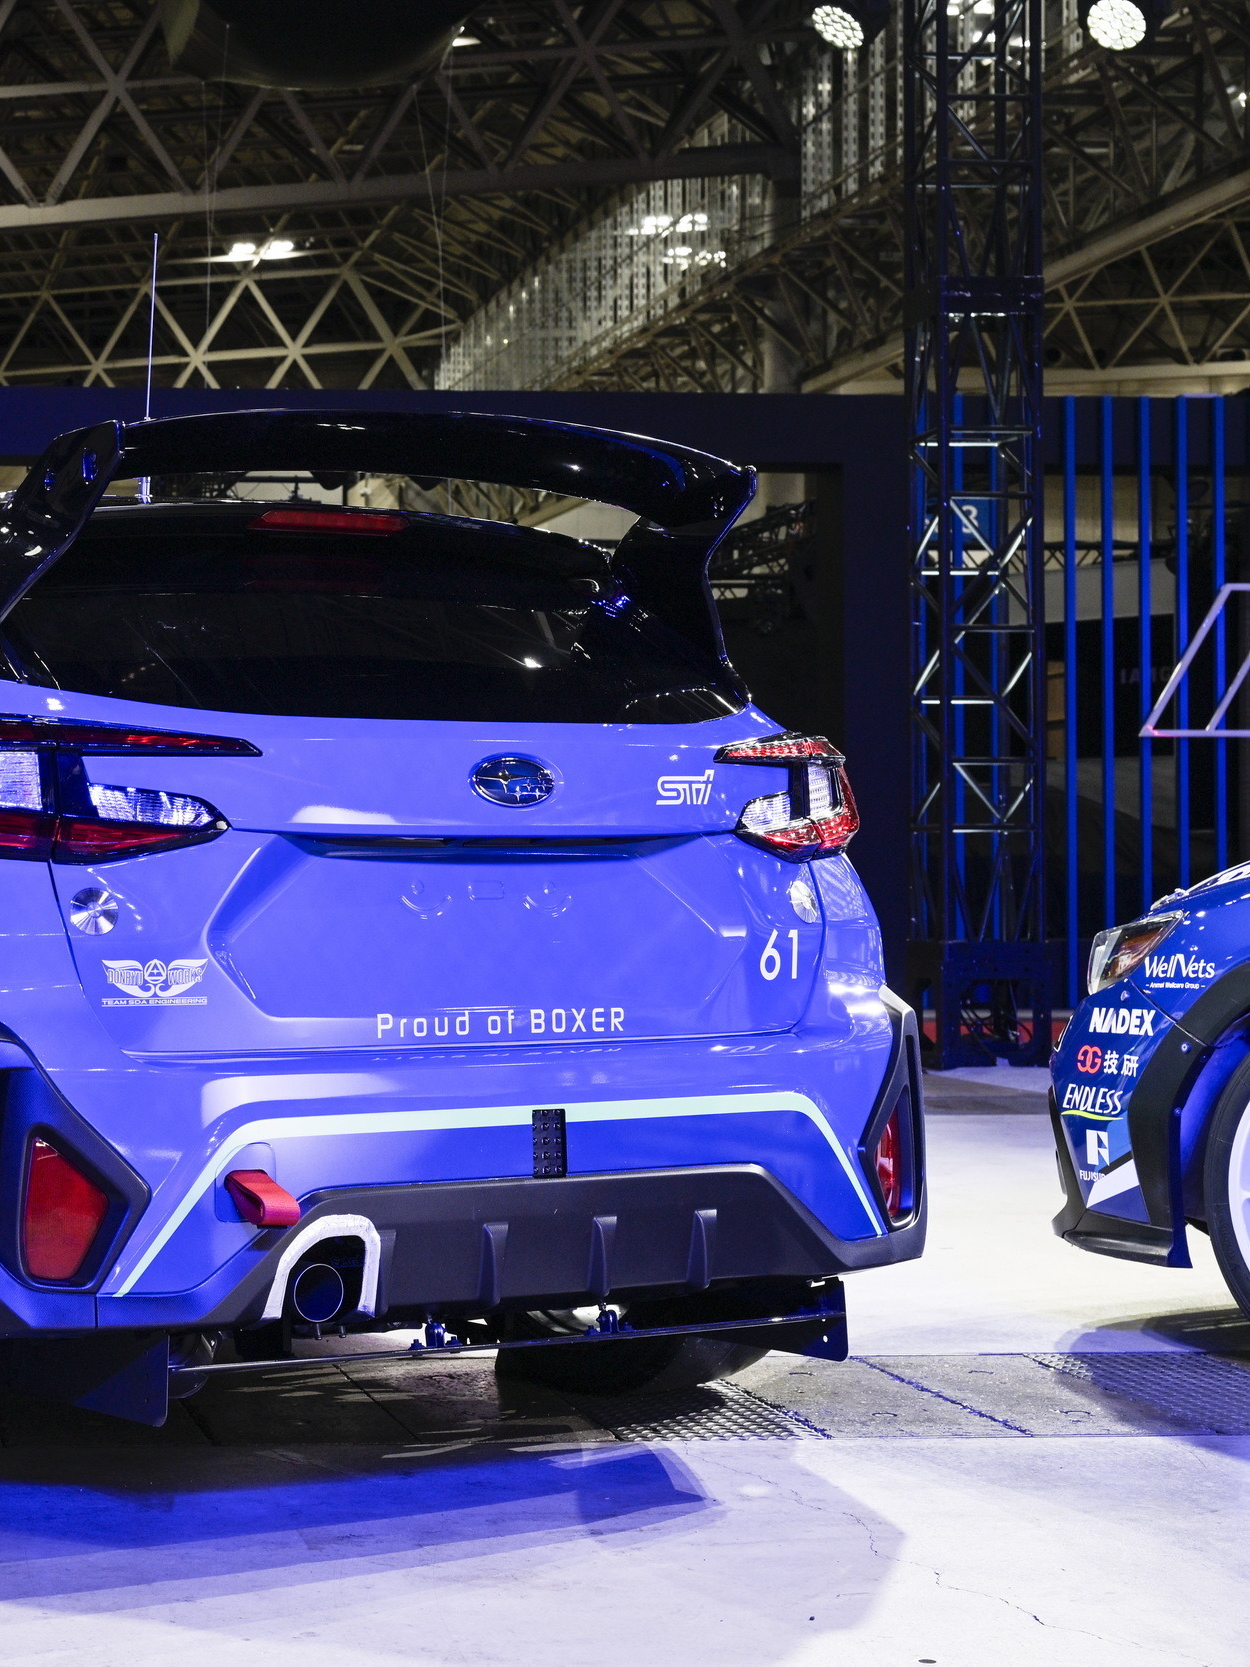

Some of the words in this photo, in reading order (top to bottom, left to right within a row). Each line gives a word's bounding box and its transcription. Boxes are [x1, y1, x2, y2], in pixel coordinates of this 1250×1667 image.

[759, 929, 799, 981] 61
[168, 967, 203, 986] WORKS
[376, 1010, 470, 1039] Proud
[487, 1009, 515, 1035] of
[530, 1007, 625, 1034] BOXER
[1088, 1007, 1157, 1036] NADEX
[1062, 1084, 1124, 1115] ENDLESS
